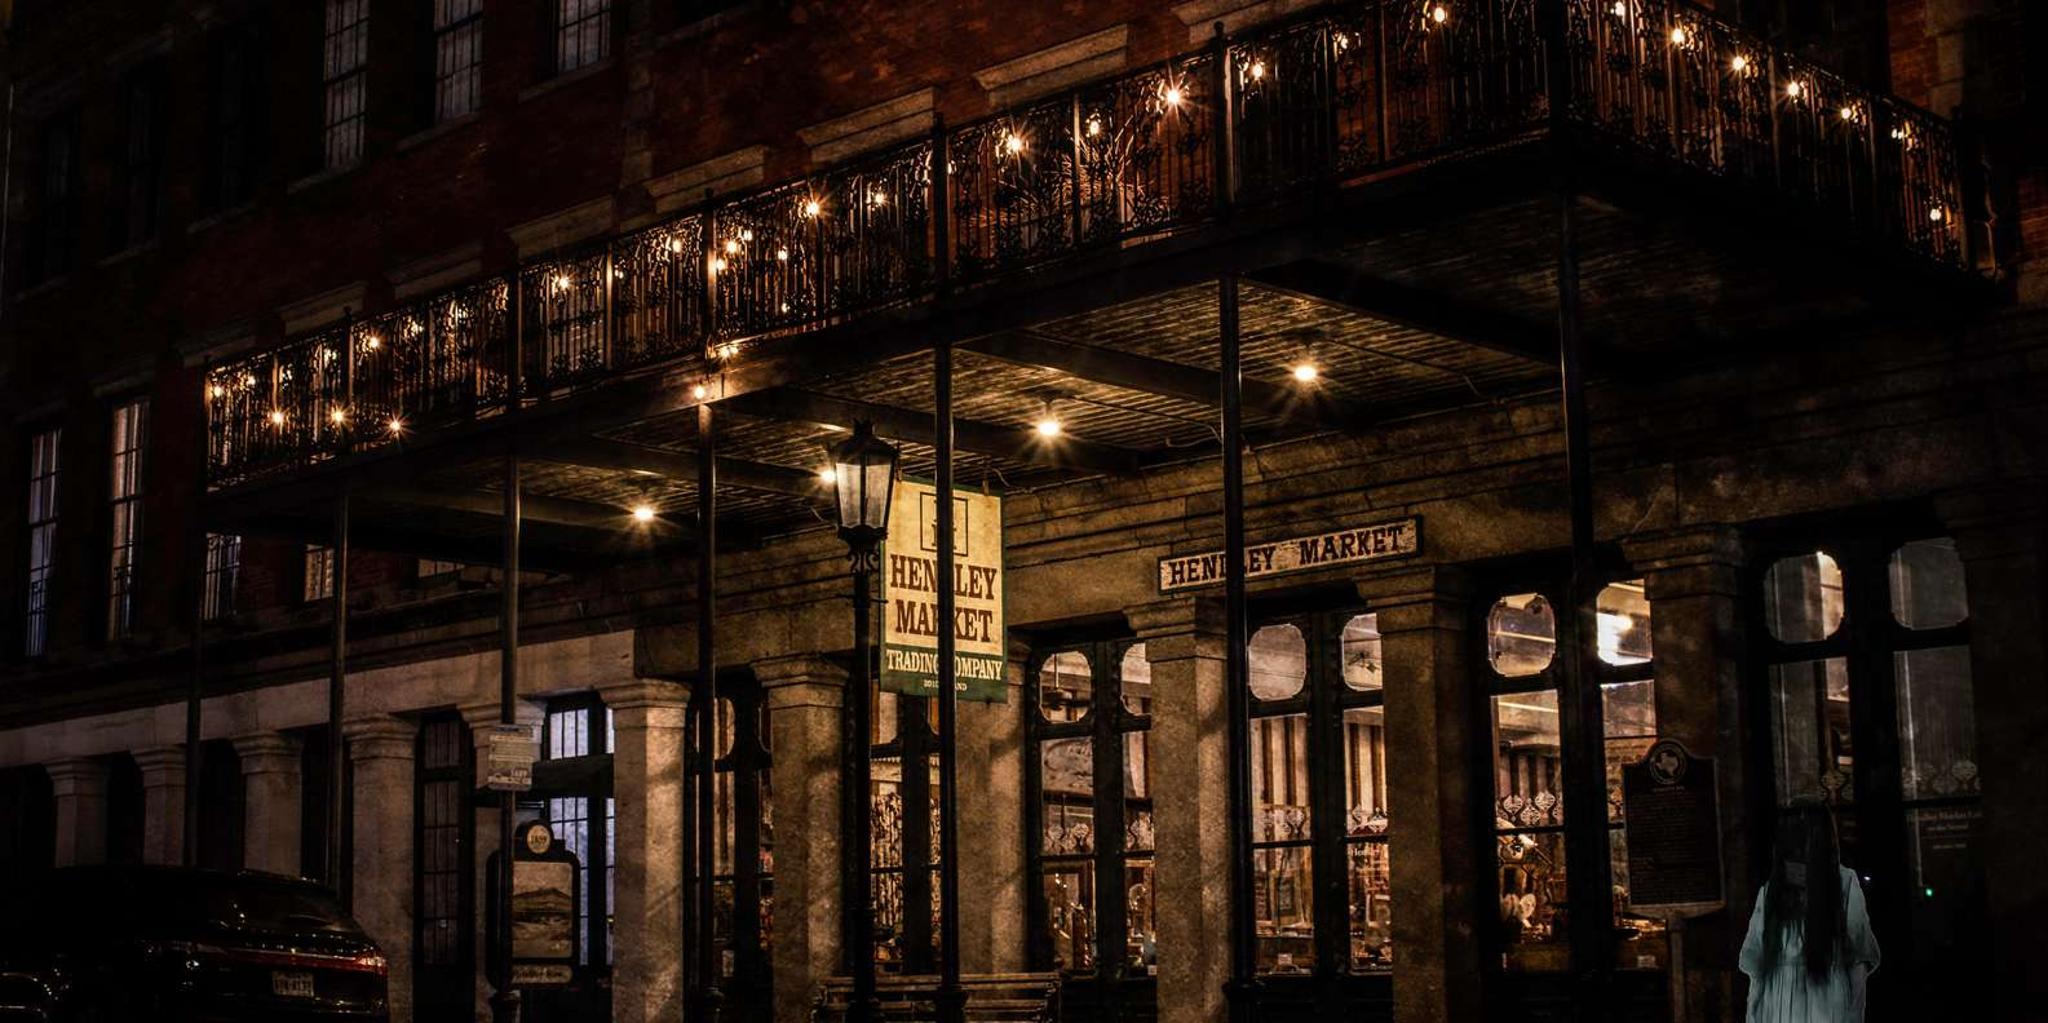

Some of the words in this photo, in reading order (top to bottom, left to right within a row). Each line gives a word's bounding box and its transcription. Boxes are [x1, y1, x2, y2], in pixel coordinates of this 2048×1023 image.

[1300, 526, 1402, 565] MARKET
[890, 554, 997, 600] HENLEY
[953, 656, 1003, 681] OMPANY
